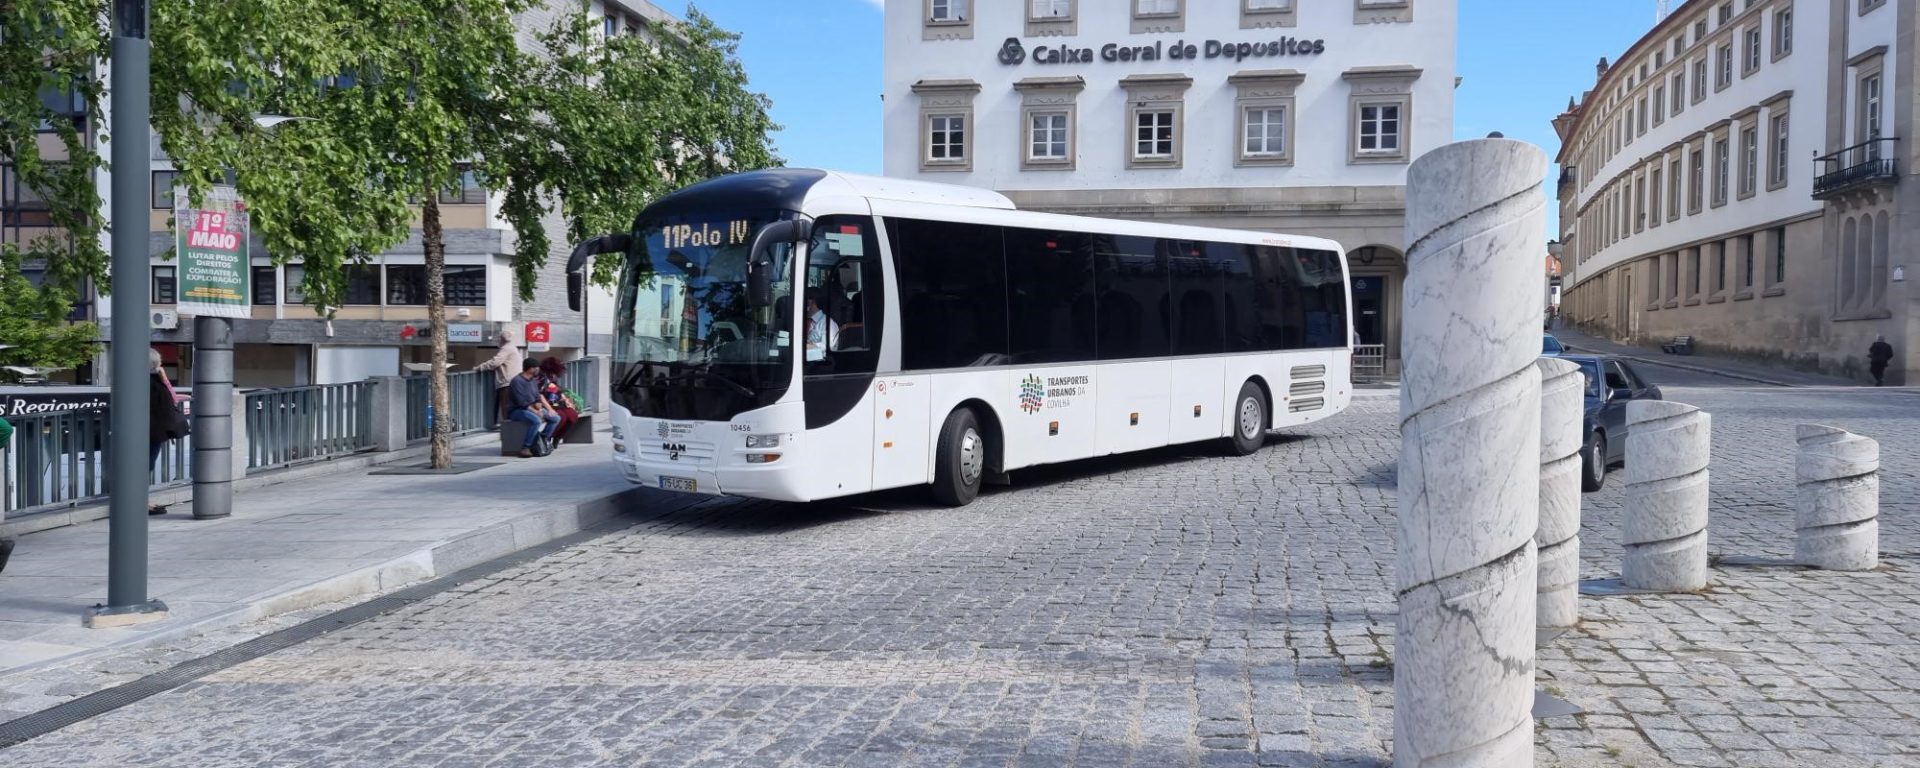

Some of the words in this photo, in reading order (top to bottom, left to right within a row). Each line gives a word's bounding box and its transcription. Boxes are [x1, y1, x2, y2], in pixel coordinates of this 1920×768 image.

[1032, 44, 1094, 65] Caixa
[1101, 41, 1161, 62] Geral
[1169, 40, 1197, 59] de
[730, 219, 748, 244] IV
[191, 230, 236, 249] MAIO
[215, 254, 239, 262] PELOS
[196, 260, 231, 268] DIREITOS
[1047, 376, 1088, 386] TRANSPORTES
[1047, 388, 1076, 398] URBANOS
[730, 424, 751, 432] 10456
[662, 442, 686, 452] MAN
